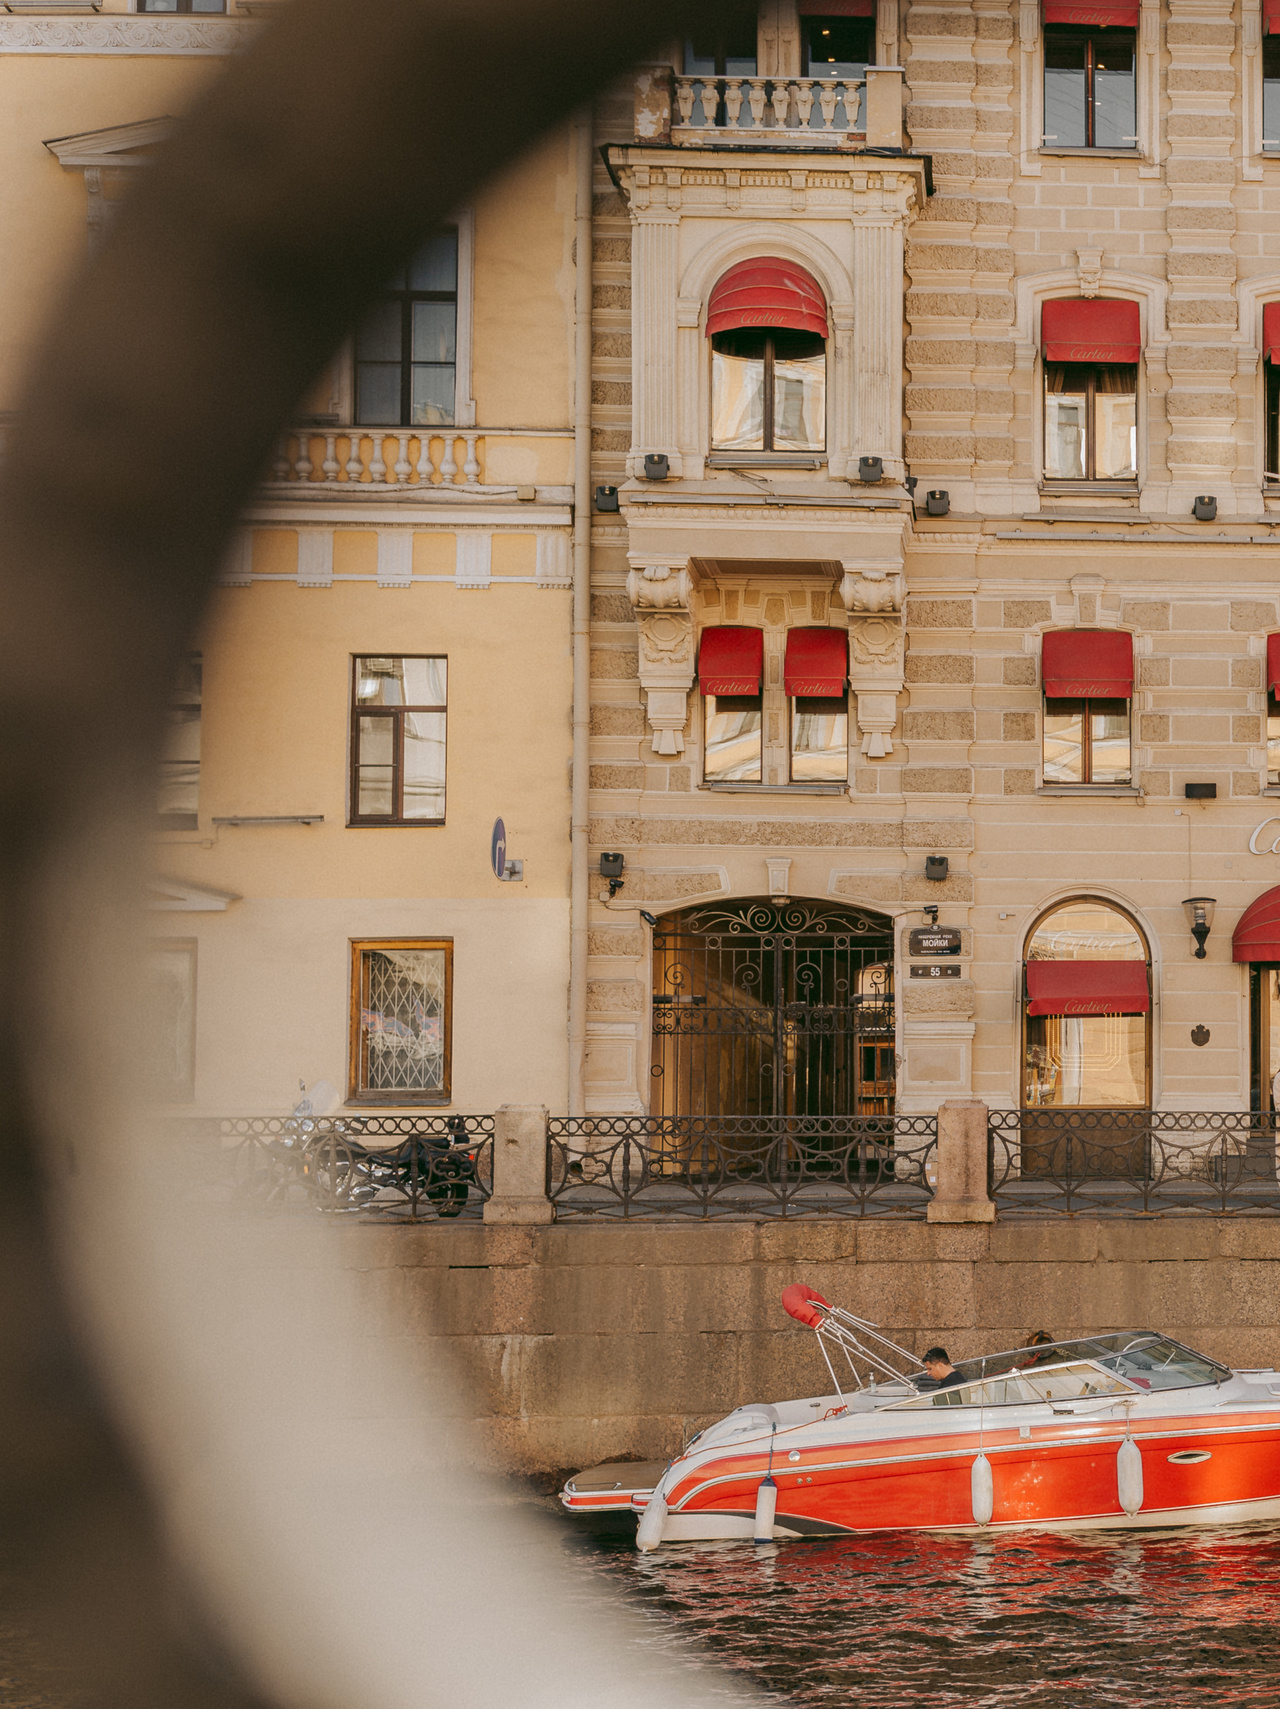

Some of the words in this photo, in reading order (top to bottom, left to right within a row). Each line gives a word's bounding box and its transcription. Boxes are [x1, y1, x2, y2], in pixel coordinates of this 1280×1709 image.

[740, 310, 788, 324] Cartier
[1070, 346, 1116, 360] Cartier
[705, 680, 753, 693] Cartier
[790, 681, 838, 694] Cartier
[1065, 683, 1112, 695] Cartier
[922, 938, 949, 947] МОЙКИ
[1050, 930, 1121, 952] Cartier
[930, 967, 941, 977] 55
[1064, 1000, 1111, 1013] Cartier
